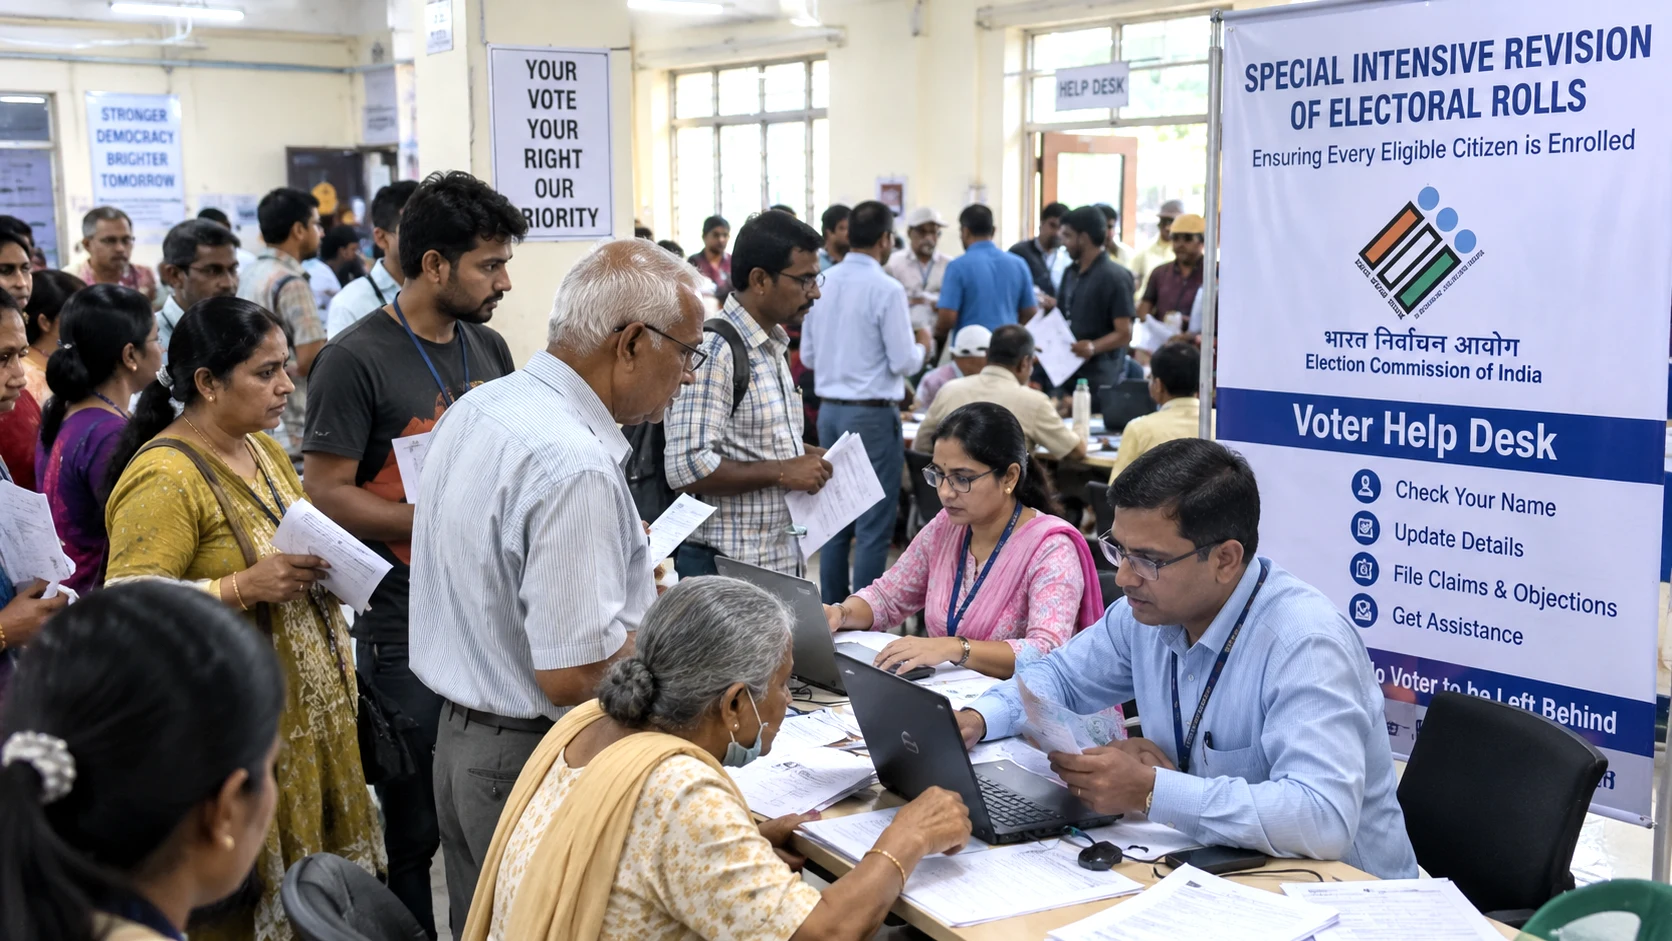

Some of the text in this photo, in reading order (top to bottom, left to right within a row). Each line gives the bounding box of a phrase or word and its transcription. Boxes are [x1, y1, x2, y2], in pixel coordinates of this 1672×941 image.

[525, 59, 577, 81] YOUR
[1245, 24, 1652, 93] SPECIAL INTENSIVE REVISION
[1060, 76, 1125, 97] HELP DESK
[527, 89, 577, 109] VOTE
[1291, 79, 1587, 130] OF ELECTORAL ROLLS
[102, 107, 168, 122] STRONGER
[97, 129, 174, 144] DEMOCRACY
[527, 119, 578, 139] YOUR
[107, 152, 168, 166] BRIGHTER
[524, 148, 583, 169] RIGHT
[1253, 128, 1636, 169] Ensuring Every Eligible Citizen is Enrolled
[102, 174, 175, 187] TOMORROW
[535, 178, 574, 198] OUR
[522, 207, 599, 228] RIORITY
[1324, 330, 1369, 350] भारत
[1374, 326, 1448, 353] निर्वाचन
[1306, 353, 1542, 384] Election Commission of India
[1293, 403, 1558, 461] Voter Help Desk
[1395, 480, 1557, 518] Check Your Name
[1395, 523, 1525, 558] Update Details
[1394, 564, 1618, 618] File Claims & Objections
[1393, 606, 1524, 646] Get Assistance
[1372, 661, 1385, 684] o
[1390, 665, 1438, 694] Voter
[1542, 697, 1617, 734] Behind
